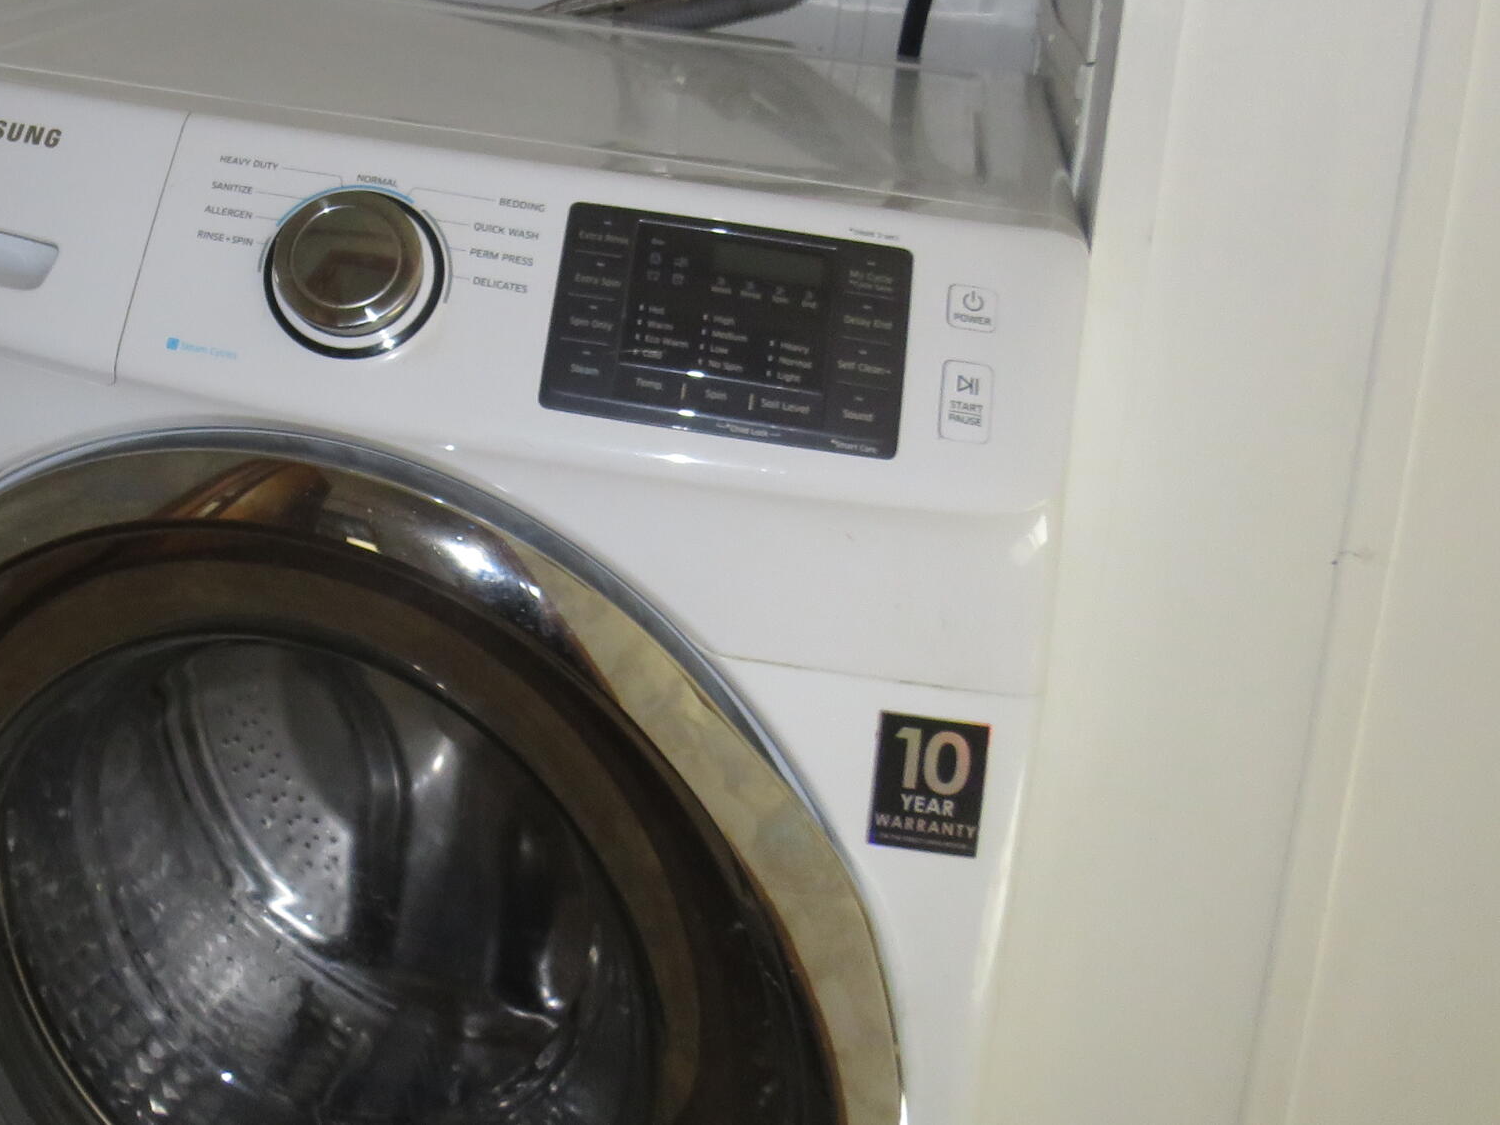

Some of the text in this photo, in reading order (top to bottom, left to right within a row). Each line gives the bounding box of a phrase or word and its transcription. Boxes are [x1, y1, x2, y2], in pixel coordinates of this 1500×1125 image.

[219, 155, 279, 171] HEAVY DUTY
[211, 181, 253, 195] SANITIZE
[356, 173, 398, 188] NORMAL
[203, 204, 253, 220] ALLERGEN
[498, 197, 546, 213] BEDDING
[473, 221, 540, 241] QUICK WASH
[469, 247, 534, 267] PERM PRESS
[472, 275, 528, 294] DELICATES
[953, 311, 992, 326] POWER
[949, 399, 984, 412] START
[948, 412, 982, 428] PAUSE
[895, 726, 972, 796] 10
[900, 792, 955, 817] YEAR
[874, 812, 978, 840] WARRANTY
